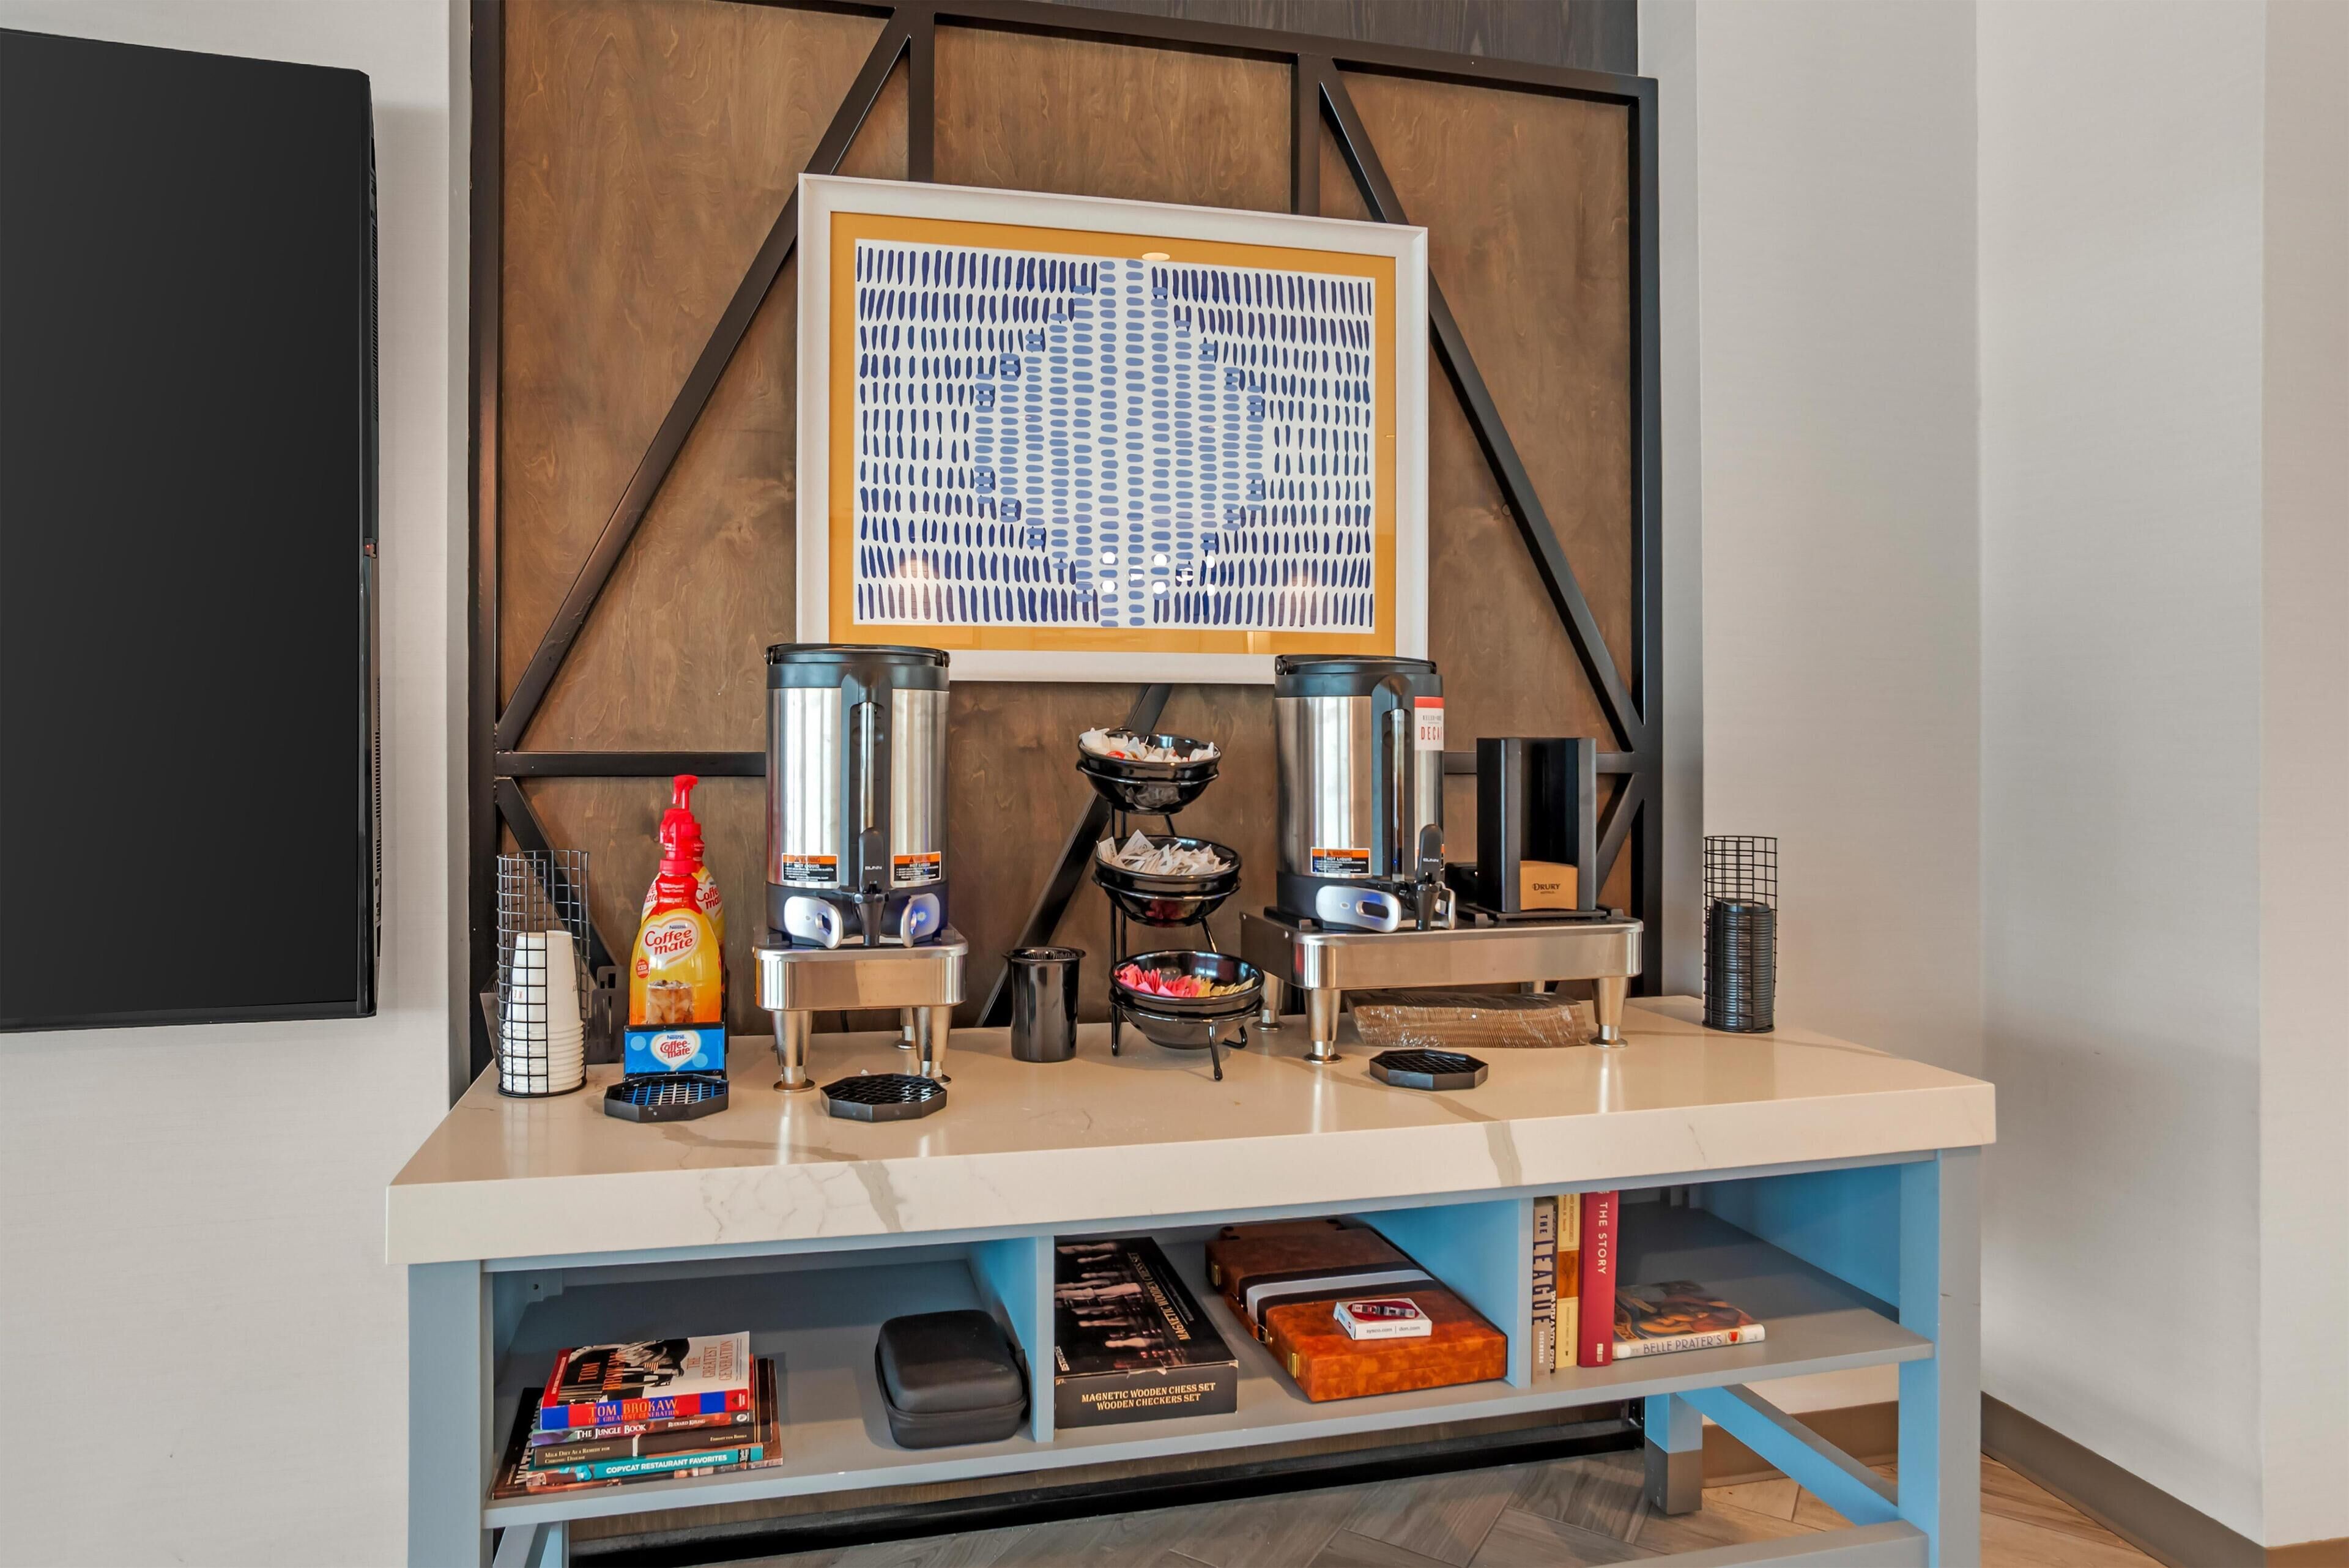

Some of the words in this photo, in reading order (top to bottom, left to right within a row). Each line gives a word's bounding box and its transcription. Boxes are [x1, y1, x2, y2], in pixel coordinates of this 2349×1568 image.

[645, 929, 692, 947] Coffee
[654, 938, 693, 955] mate
[667, 1047, 691, 1059] mate
[1539, 1214, 1548, 1234] THE
[1598, 1202, 1608, 1227] THE
[1598, 1233, 1608, 1275] STORY
[1532, 1239, 1554, 1326] LEAGUE
[1644, 1340, 1672, 1354] BELLE
[1675, 1334, 1723, 1349] PRATER'S
[577, 1362, 601, 1383] TOM
[686, 1356, 701, 1370] THE
[1082, 1390, 1129, 1402] MAGNETIC
[1130, 1386, 1168, 1397] WOODEN
[1168, 1383, 1197, 1394] CHESS
[1198, 1382, 1216, 1391] SET
[1097, 1400, 1134, 1410] WOODEN
[1136, 1395, 1182, 1406] CHECKERS
[1184, 1393, 1201, 1402] SET
[588, 1404, 617, 1418] TOM
[623, 1399, 678, 1414] BROKAW
[603, 1413, 637, 1422] GREATEST
[575, 1430, 592, 1440] THE
[595, 1427, 622, 1439] JUNGLE
[624, 1424, 647, 1435] BOOK
[606, 1464, 639, 1474] COPYCAT
[640, 1458, 688, 1470] RESTAURANT
[689, 1454, 727, 1465] FAVORITES
